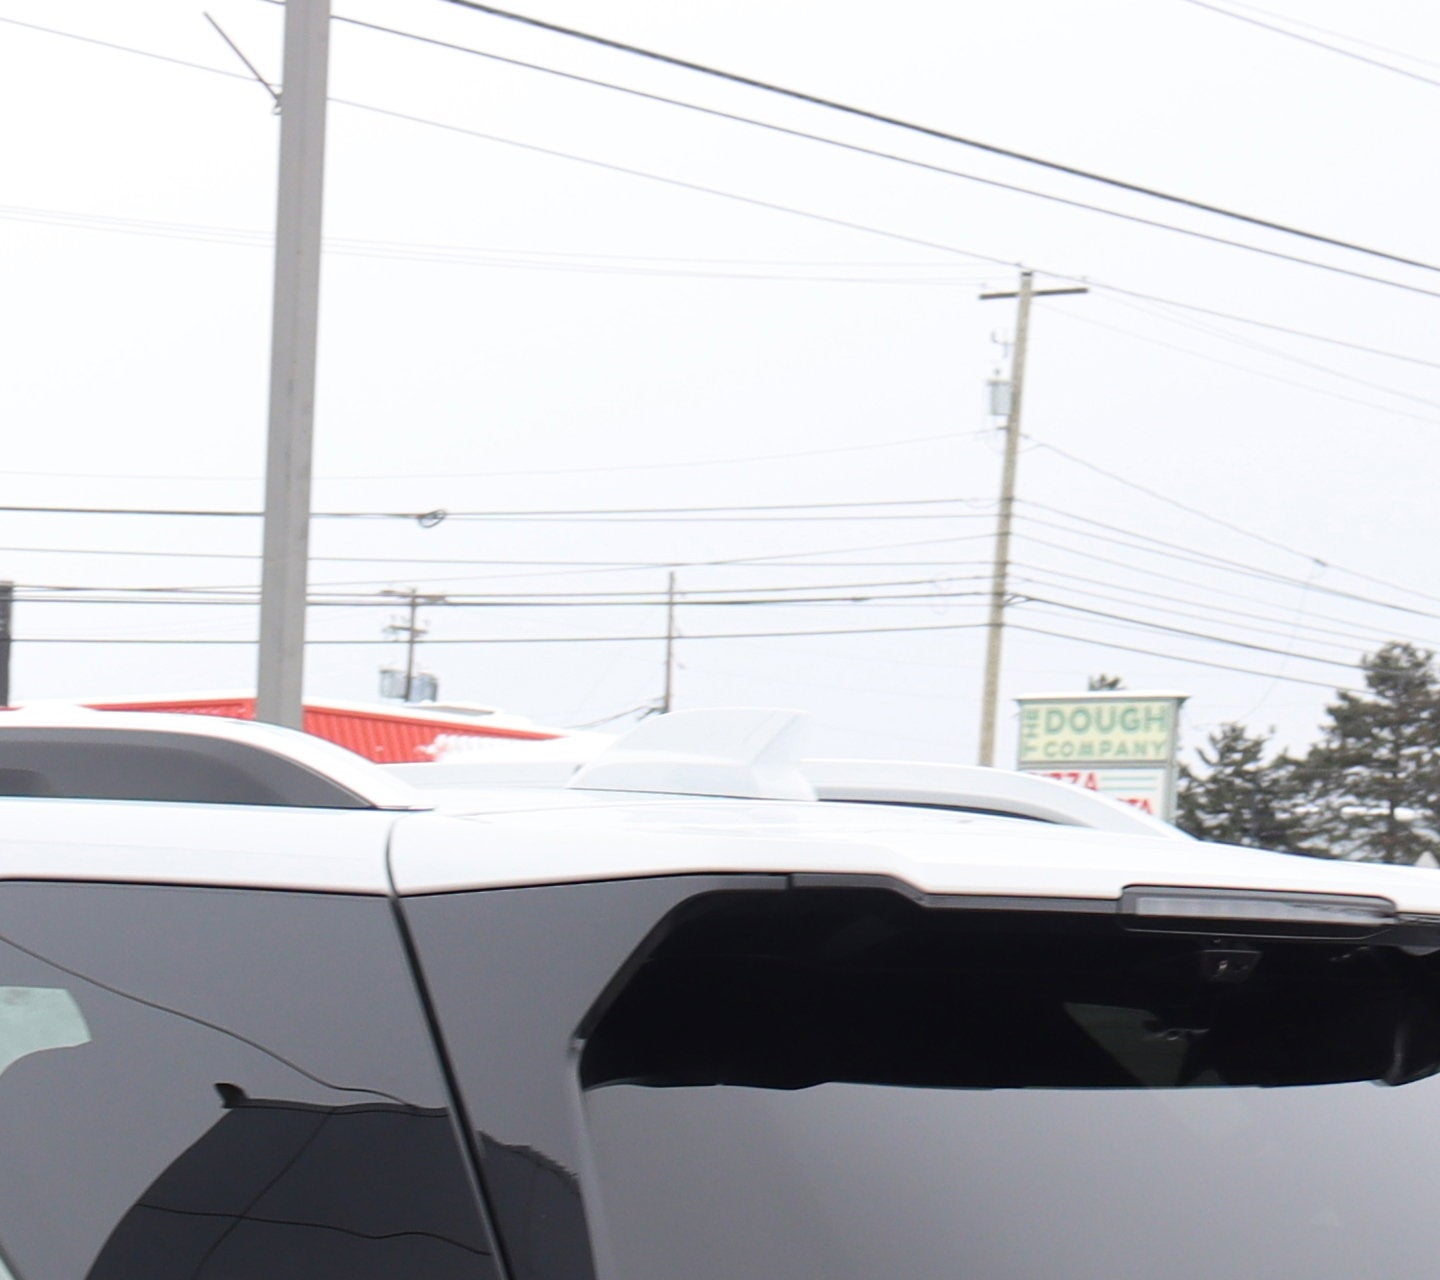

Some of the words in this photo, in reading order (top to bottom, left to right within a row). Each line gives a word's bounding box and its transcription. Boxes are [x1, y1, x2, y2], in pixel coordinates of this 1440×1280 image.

[1023, 709, 1040, 755] THE
[1045, 706, 1168, 734] DOUGH
[1044, 741, 1165, 757] COMPANY
